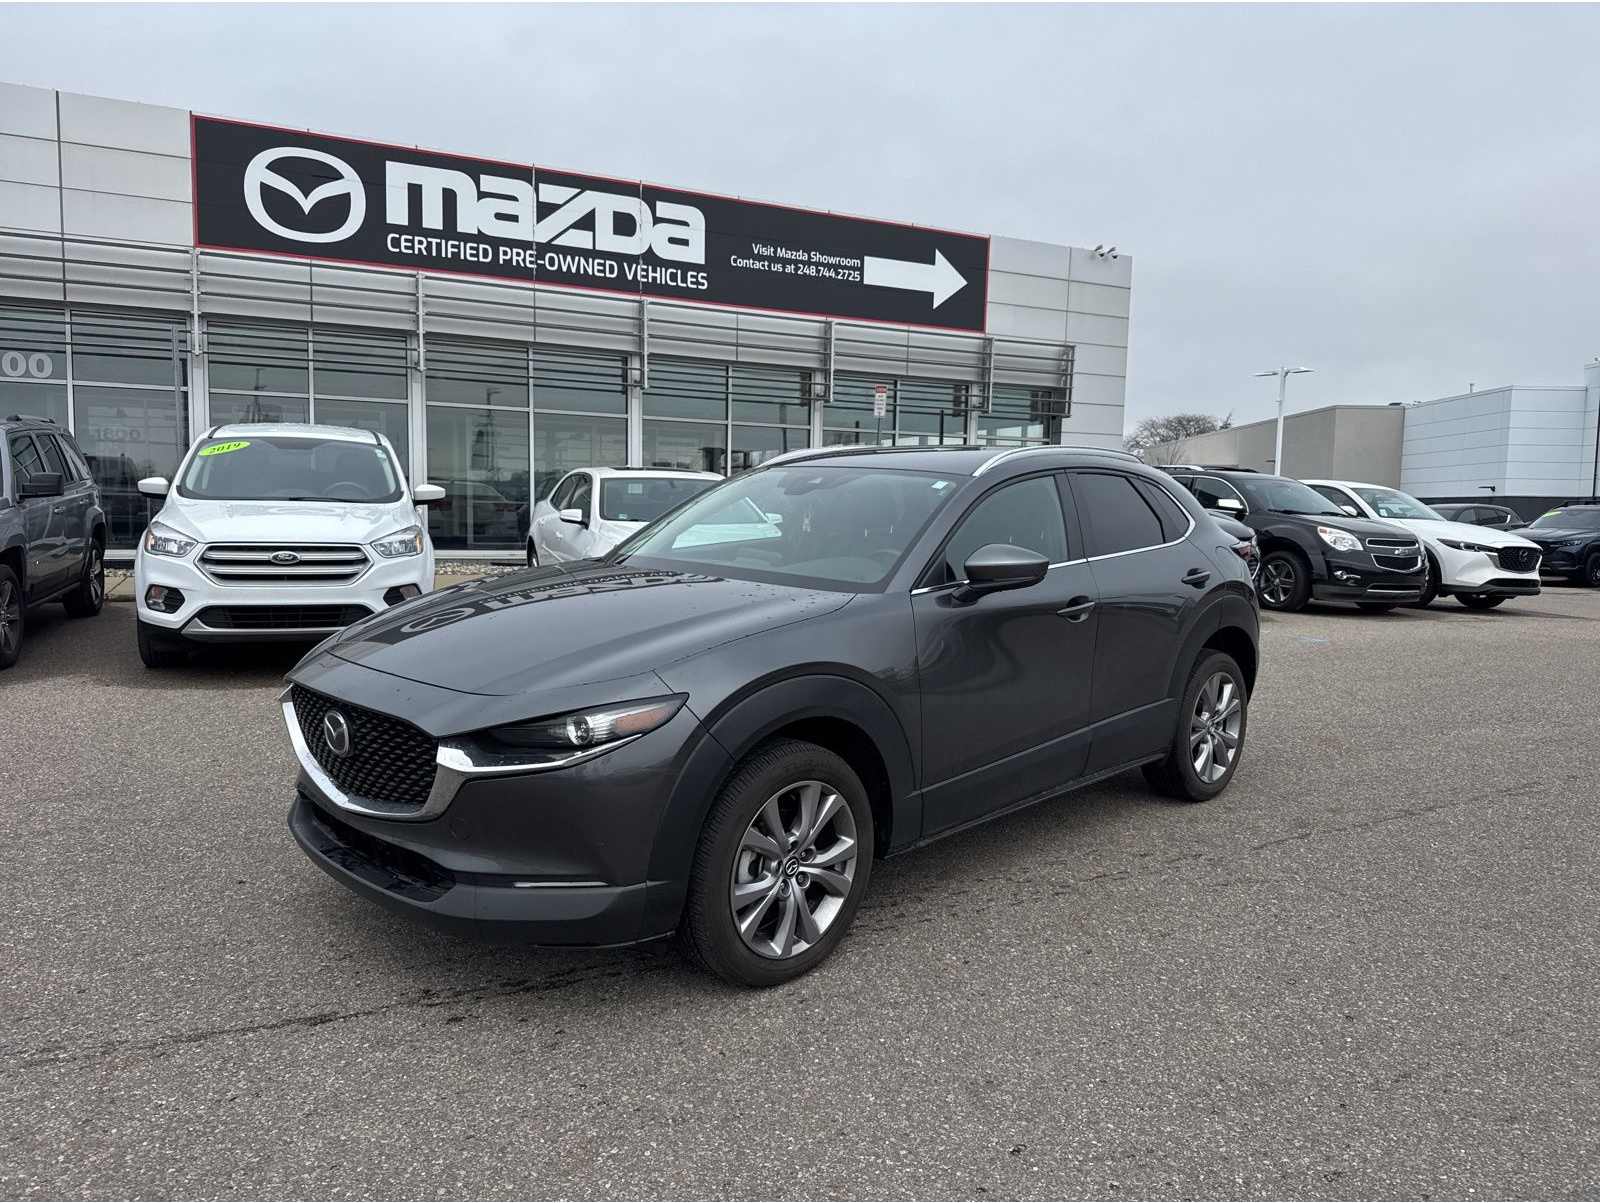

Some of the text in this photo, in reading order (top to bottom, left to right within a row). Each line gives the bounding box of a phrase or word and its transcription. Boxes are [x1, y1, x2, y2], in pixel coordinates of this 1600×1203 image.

[385, 160, 706, 264] mazda
[386, 233, 708, 290] CERTIFIED PRE-OWNED VEHICLES
[730, 255, 861, 282] Contact us at 248.744.2725
[752, 243, 861, 268] Visit Mazda Showroom
